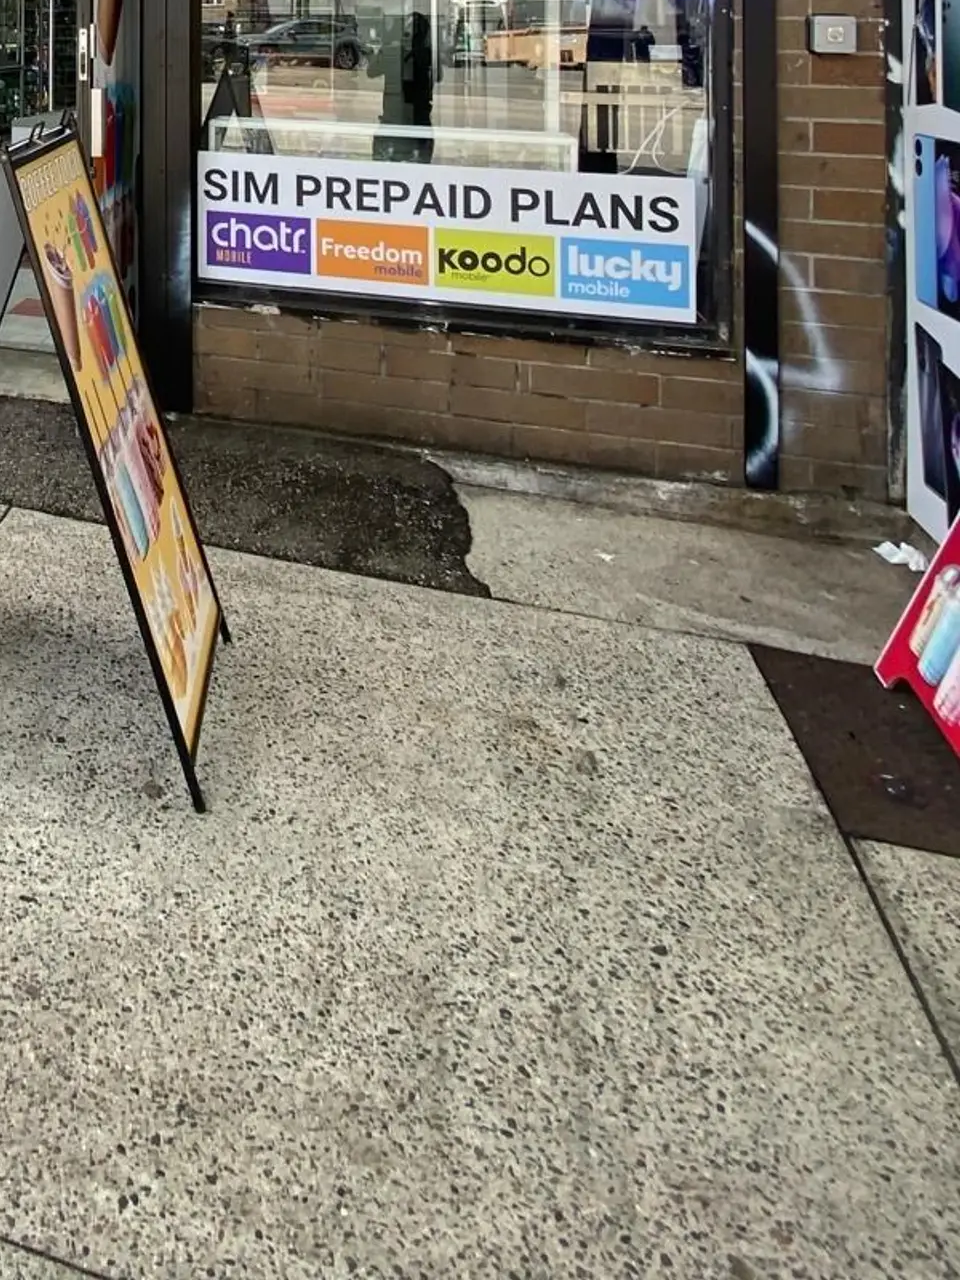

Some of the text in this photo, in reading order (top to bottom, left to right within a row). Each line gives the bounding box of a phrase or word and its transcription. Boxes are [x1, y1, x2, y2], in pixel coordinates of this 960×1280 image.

[203, 168, 680, 233] SIM PREPAID PLANS
[211, 217, 306, 254] chatr
[216, 250, 251, 264] MOBILE
[321, 237, 422, 264] Freedom
[374, 263, 423, 279] mobile
[568, 246, 682, 288] lucky
[568, 280, 630, 298] mobile
